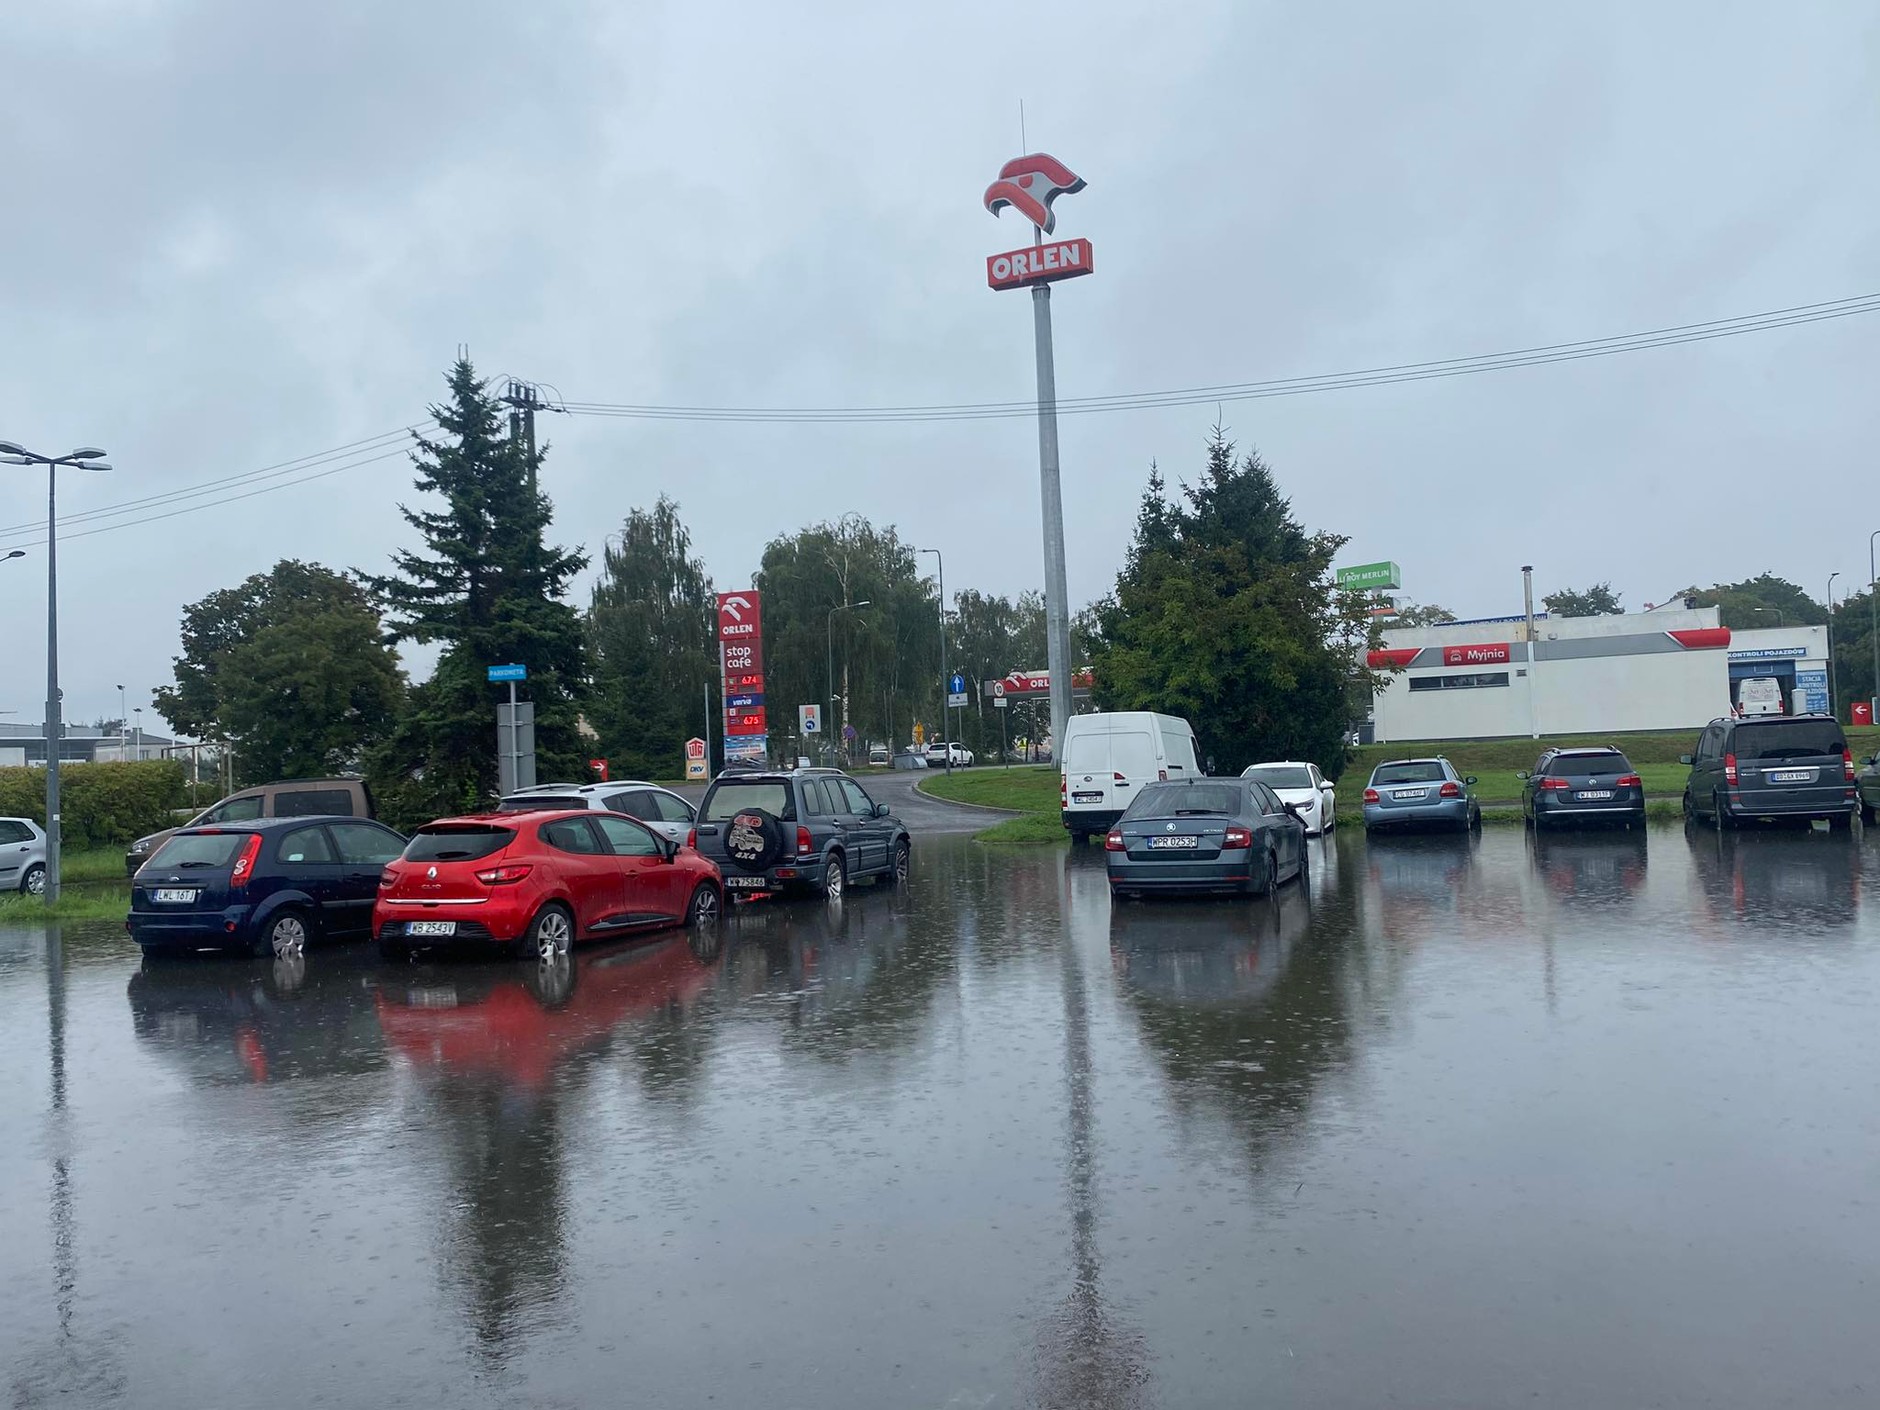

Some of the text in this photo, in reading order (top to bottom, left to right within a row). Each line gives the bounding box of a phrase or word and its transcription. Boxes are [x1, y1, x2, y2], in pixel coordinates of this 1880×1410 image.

[992, 244, 1080, 279] ORLEN
[1362, 570, 1390, 579] MERLIN
[722, 624, 753, 635] ORLEN
[726, 646, 751, 657] stop
[1467, 648, 1505, 661] Myjnia
[727, 657, 752, 668] cafe
[1153, 837, 1197, 847] WPR 0253H
[425, 922, 455, 933] 2543V
